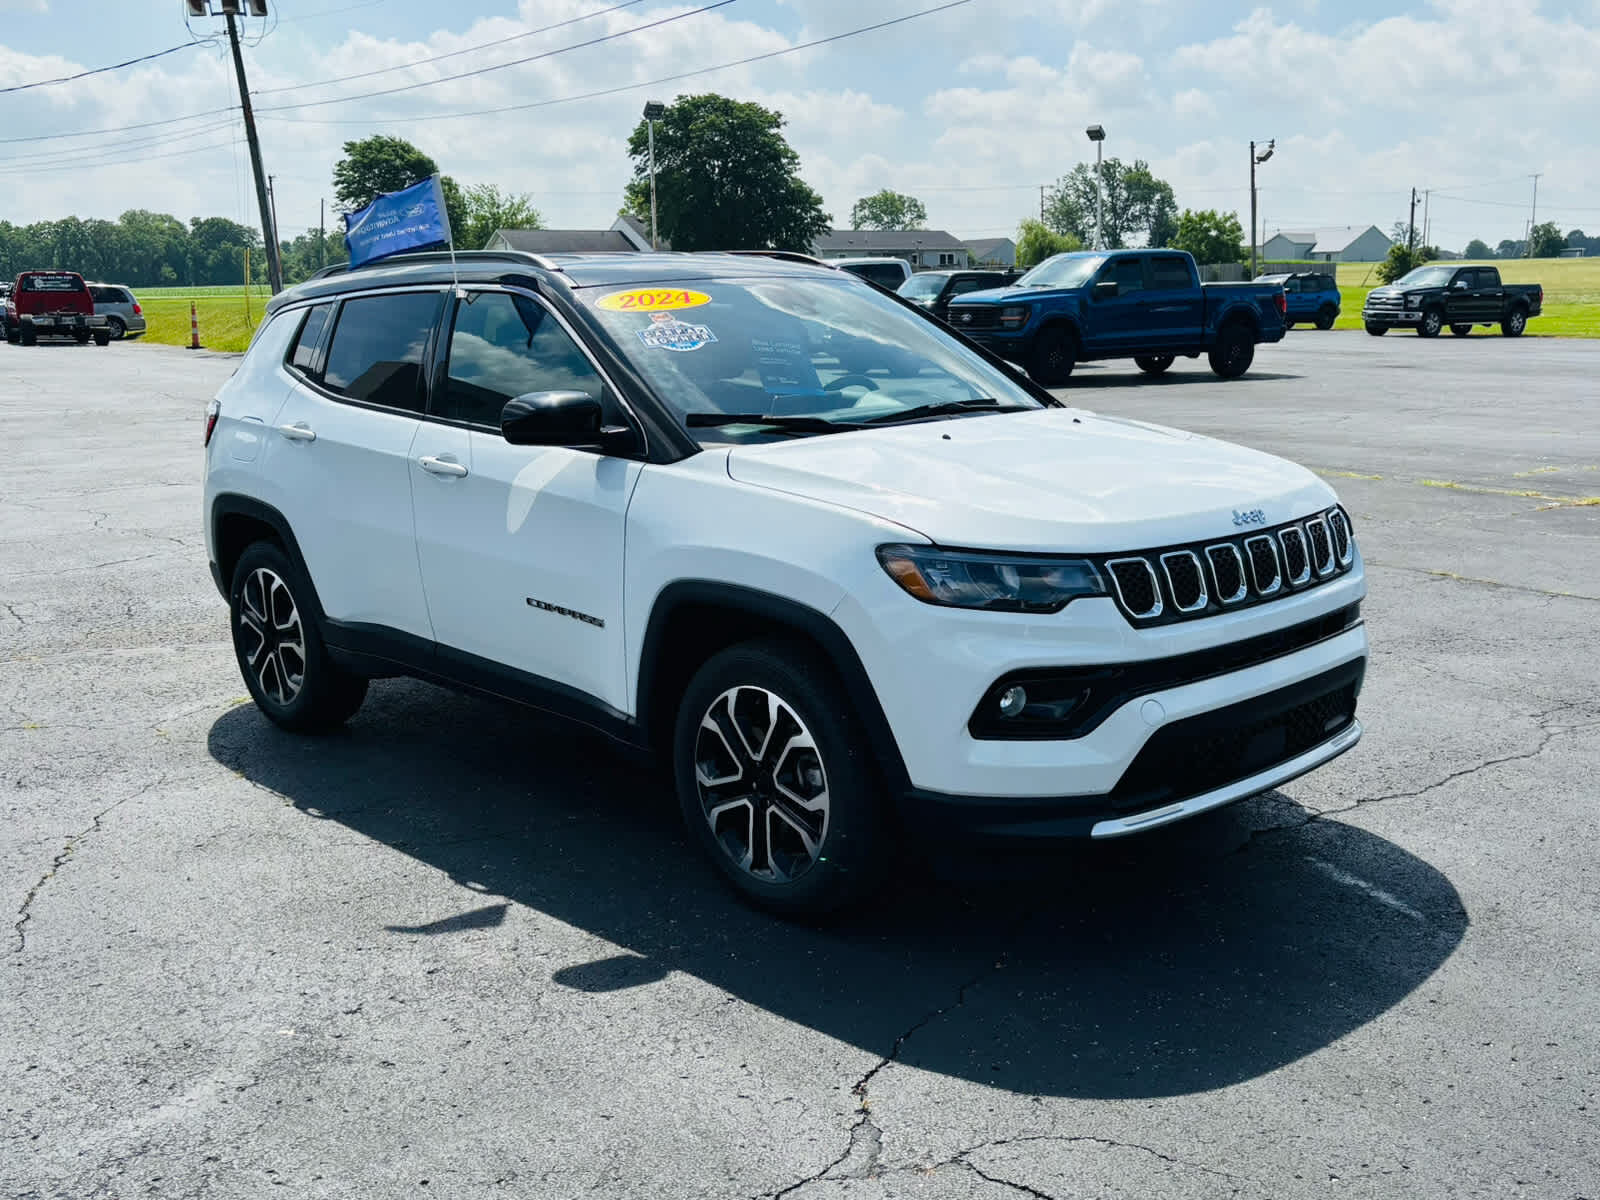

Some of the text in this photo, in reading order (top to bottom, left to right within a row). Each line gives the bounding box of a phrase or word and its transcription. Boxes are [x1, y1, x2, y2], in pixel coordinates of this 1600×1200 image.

[620, 292, 693, 308] 2024
[1233, 509, 1266, 526] Jeep
[526, 597, 605, 628] COMPASS
